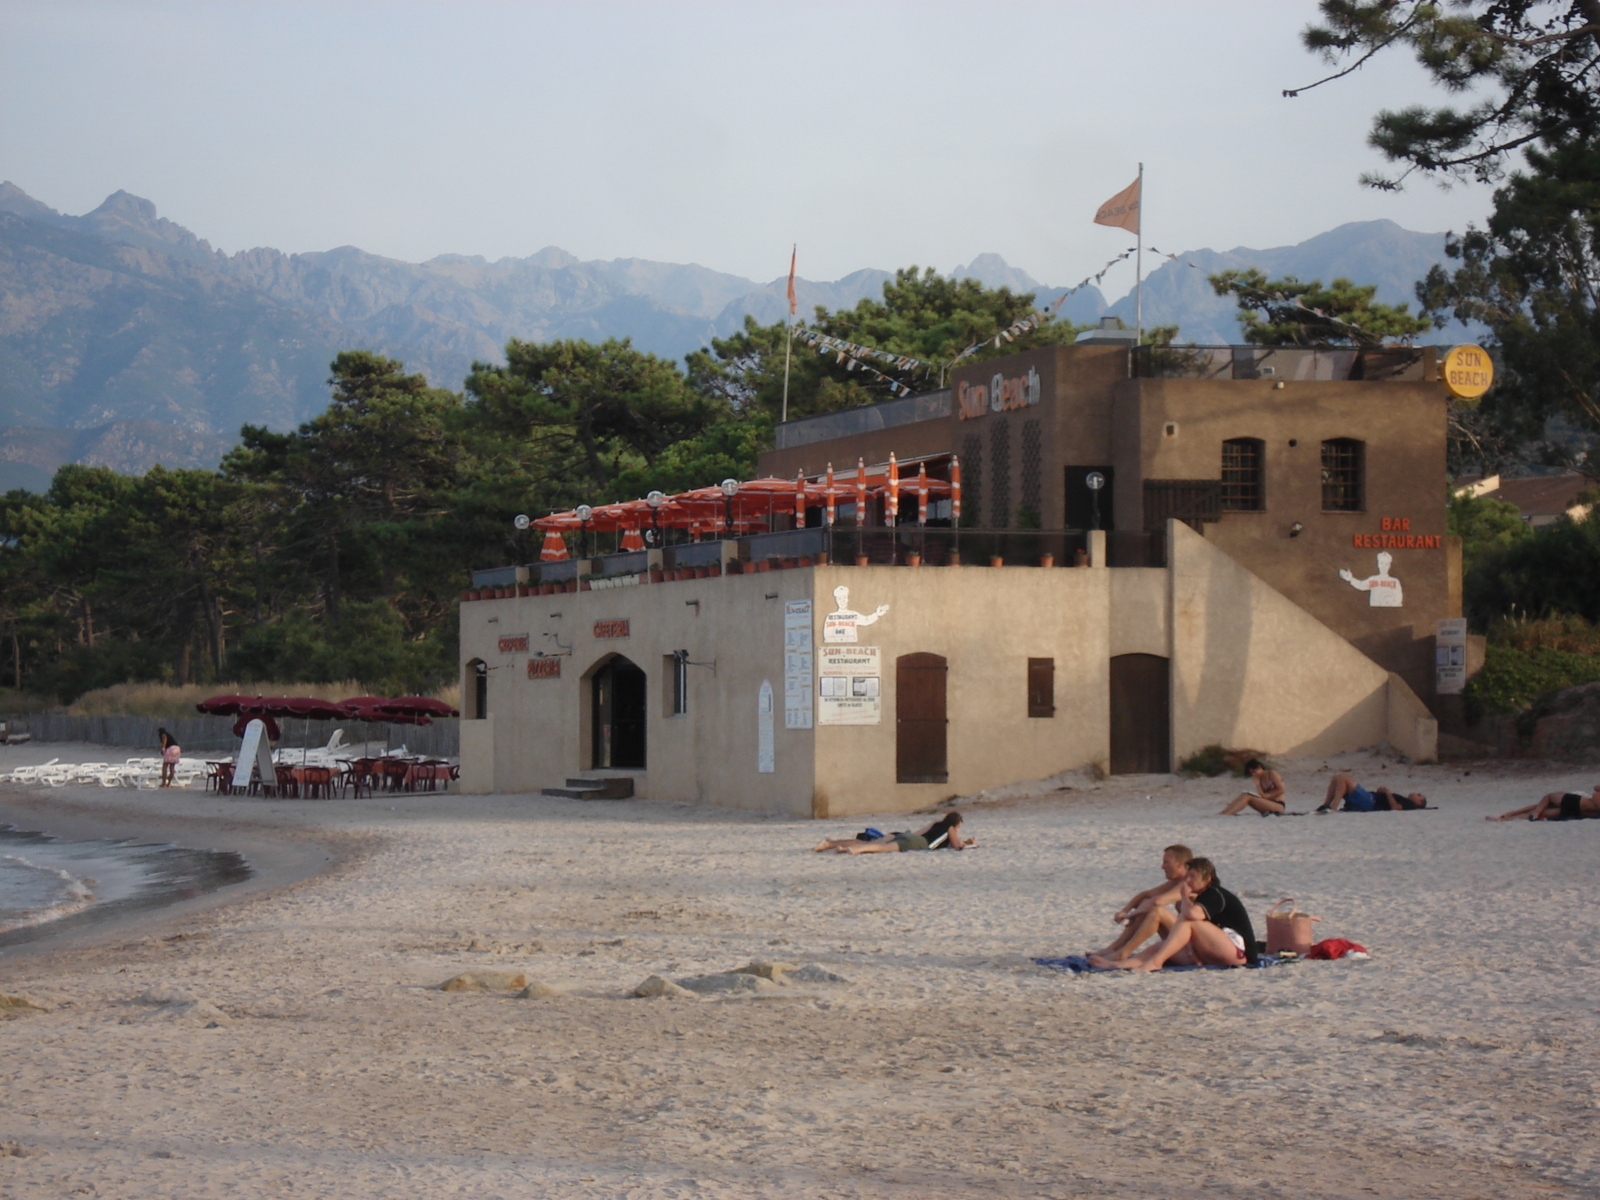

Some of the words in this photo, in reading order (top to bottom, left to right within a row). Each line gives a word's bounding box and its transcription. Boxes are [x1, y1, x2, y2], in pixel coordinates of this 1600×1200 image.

[1457, 352, 1481, 367] SUN
[1450, 370, 1488, 386] BEACH
[958, 380, 989, 421] Sun
[991, 365, 1041, 412] Beach
[1381, 517, 1410, 531] BAR
[1354, 534, 1442, 548] RESTAURANT
